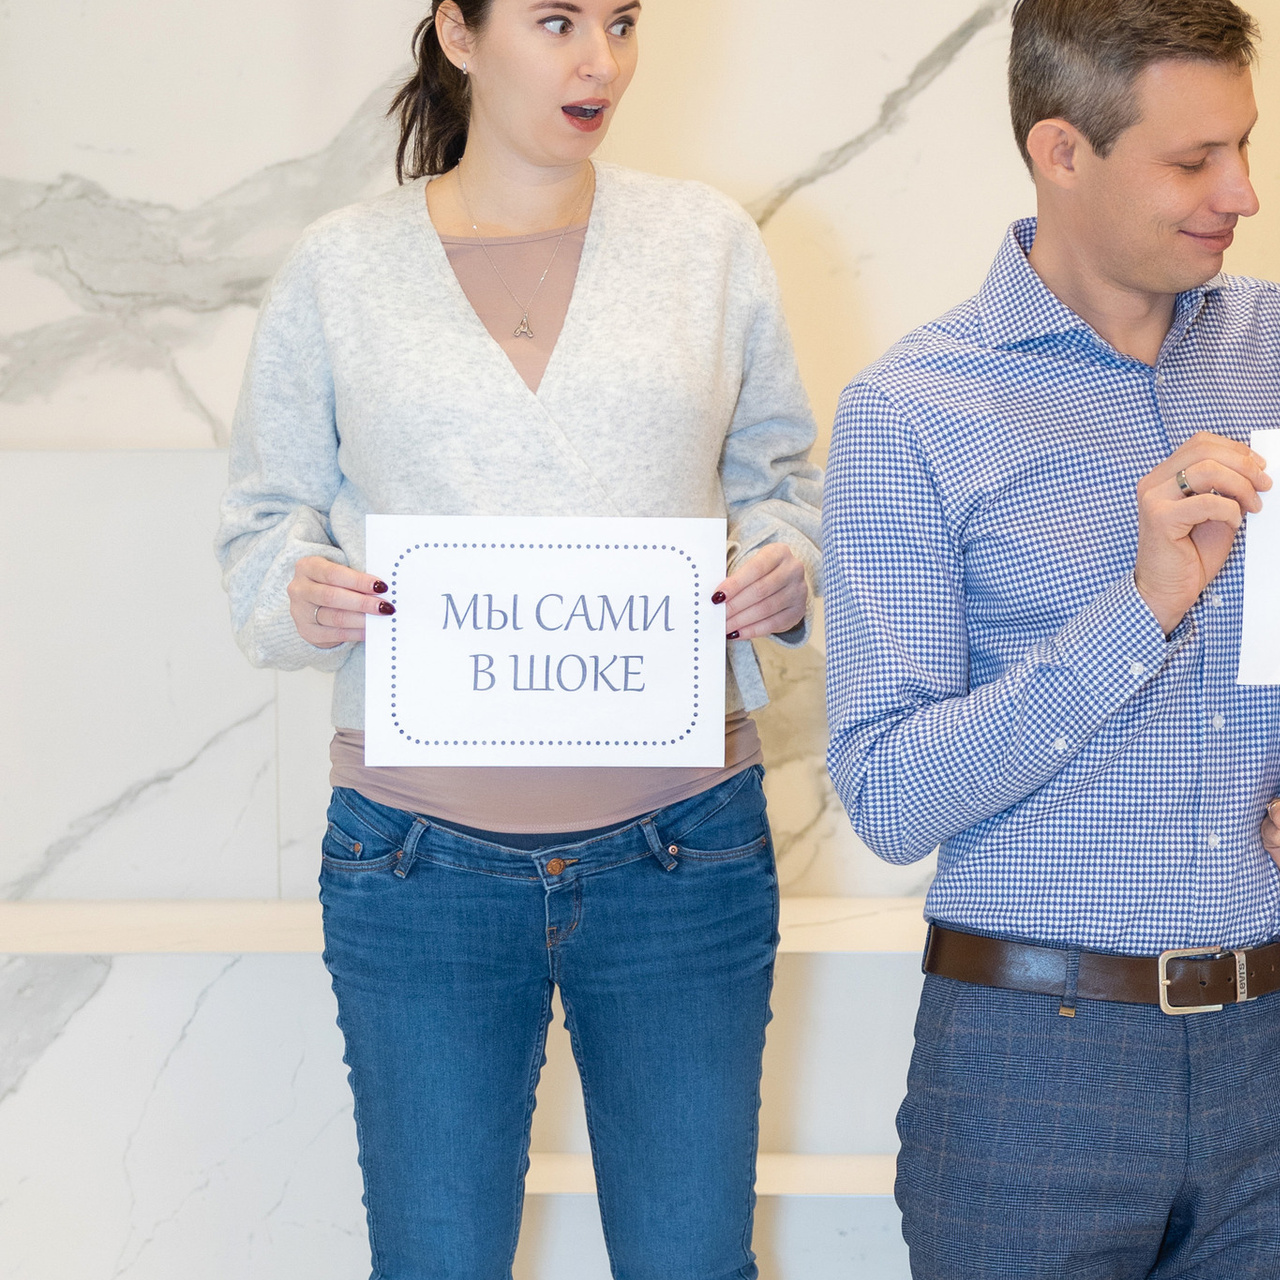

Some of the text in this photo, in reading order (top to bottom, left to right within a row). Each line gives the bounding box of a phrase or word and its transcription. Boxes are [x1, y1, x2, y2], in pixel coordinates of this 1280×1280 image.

[440, 593, 676, 632] МЫ САМИ
[468, 653, 646, 693] В ШОКЕ
